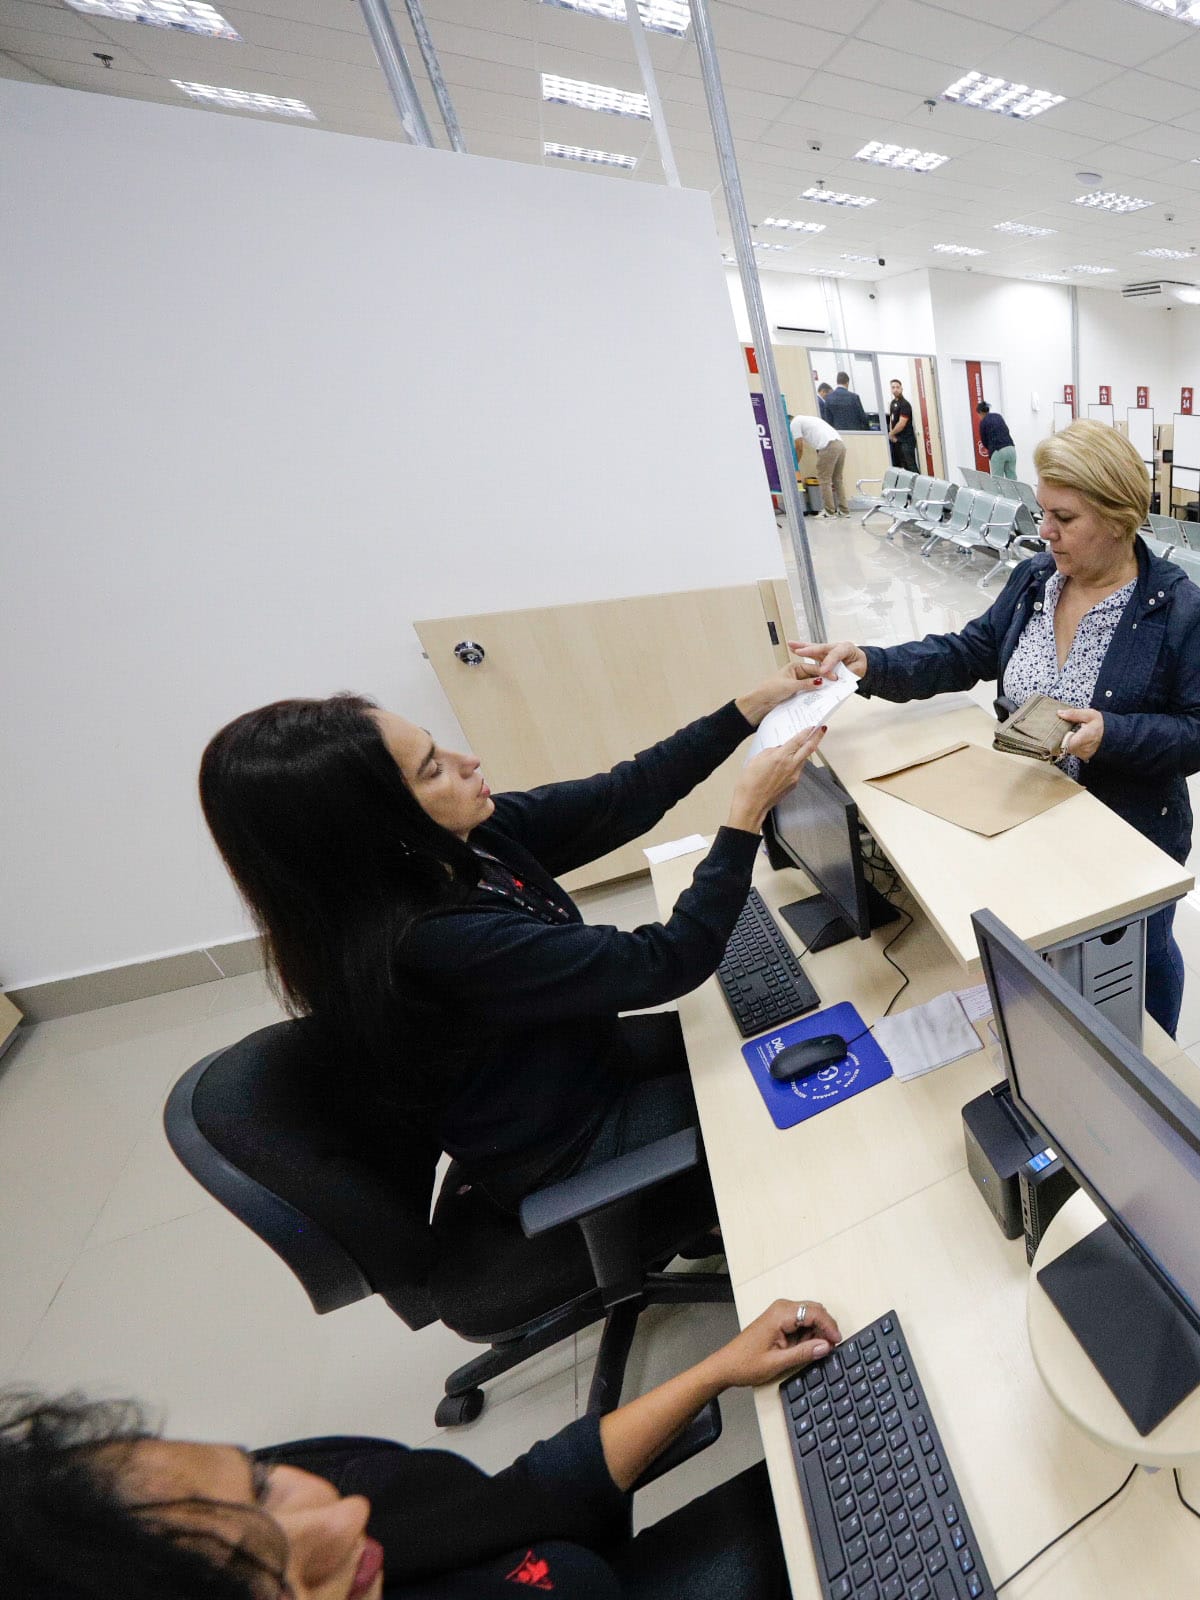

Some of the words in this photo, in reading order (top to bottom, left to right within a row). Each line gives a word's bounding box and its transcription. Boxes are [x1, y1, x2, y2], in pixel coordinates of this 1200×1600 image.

[1066, 394, 1073, 402] 11
[1100, 395, 1107, 403] 12
[1138, 397, 1146, 406] 13
[1182, 399, 1190, 409] 14
